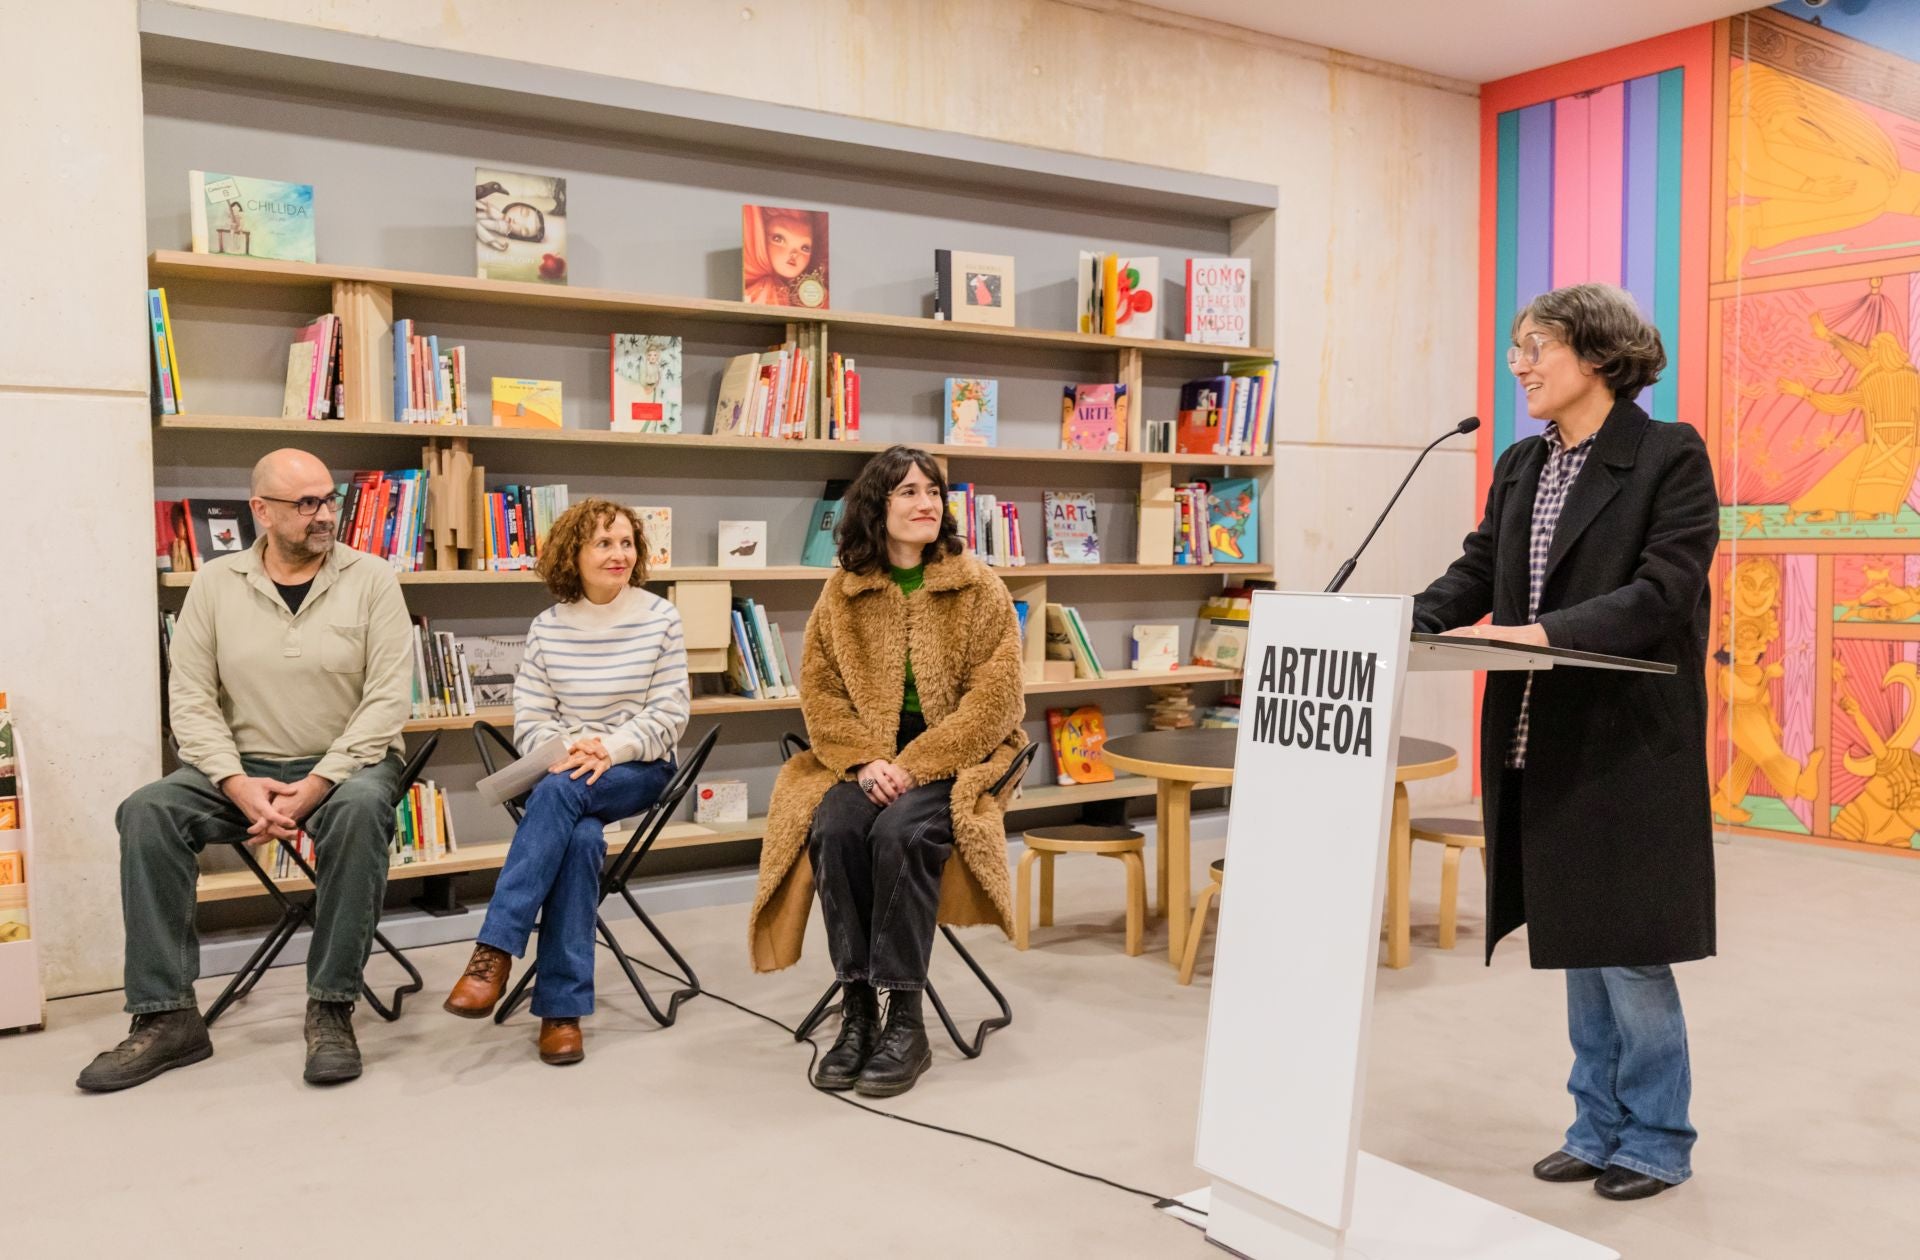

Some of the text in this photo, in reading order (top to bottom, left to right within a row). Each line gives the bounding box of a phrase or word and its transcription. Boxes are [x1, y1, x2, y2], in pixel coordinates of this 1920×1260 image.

[247, 199, 307, 217] CHILLIDA
[1196, 314, 1244, 332] MUSEO
[1078, 406, 1113, 420] ARTE
[1053, 504, 1087, 521] ART
[1258, 645, 1377, 702] ARTIUM
[1252, 695, 1372, 757] MUSEOA
